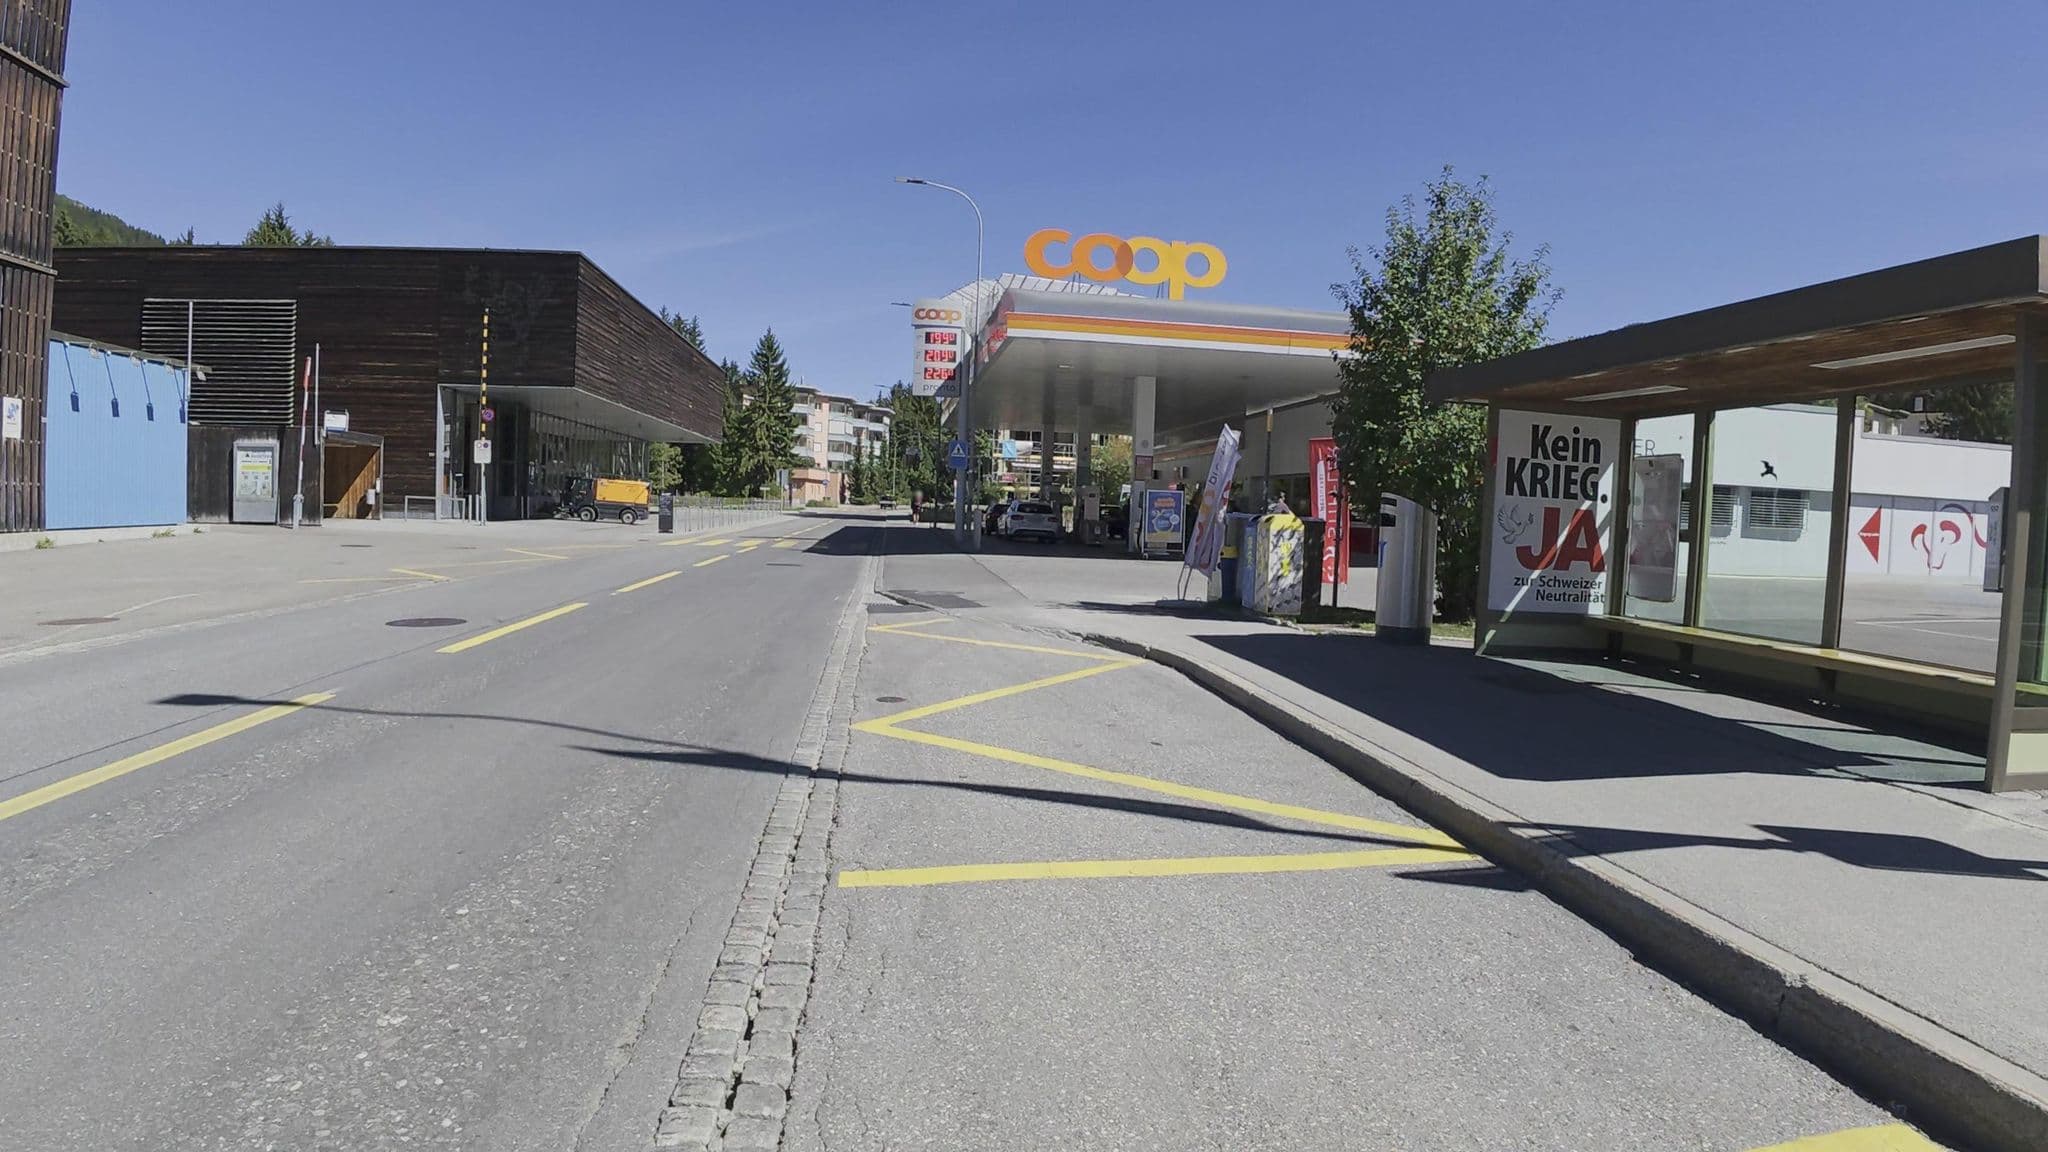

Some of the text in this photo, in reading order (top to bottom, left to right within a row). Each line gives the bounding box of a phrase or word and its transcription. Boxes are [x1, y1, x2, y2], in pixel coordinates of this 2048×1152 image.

[1024, 228, 1227, 300] coop
[915, 308, 961, 324] coop
[923, 383, 956, 393] pronto
[1531, 424, 1601, 464] Kein
[1505, 456, 1608, 504] KRIEG.
[1516, 506, 1606, 573] JA
[1513, 575, 1603, 590] zur Schweizer
[1535, 589, 1605, 604] Neutralität
